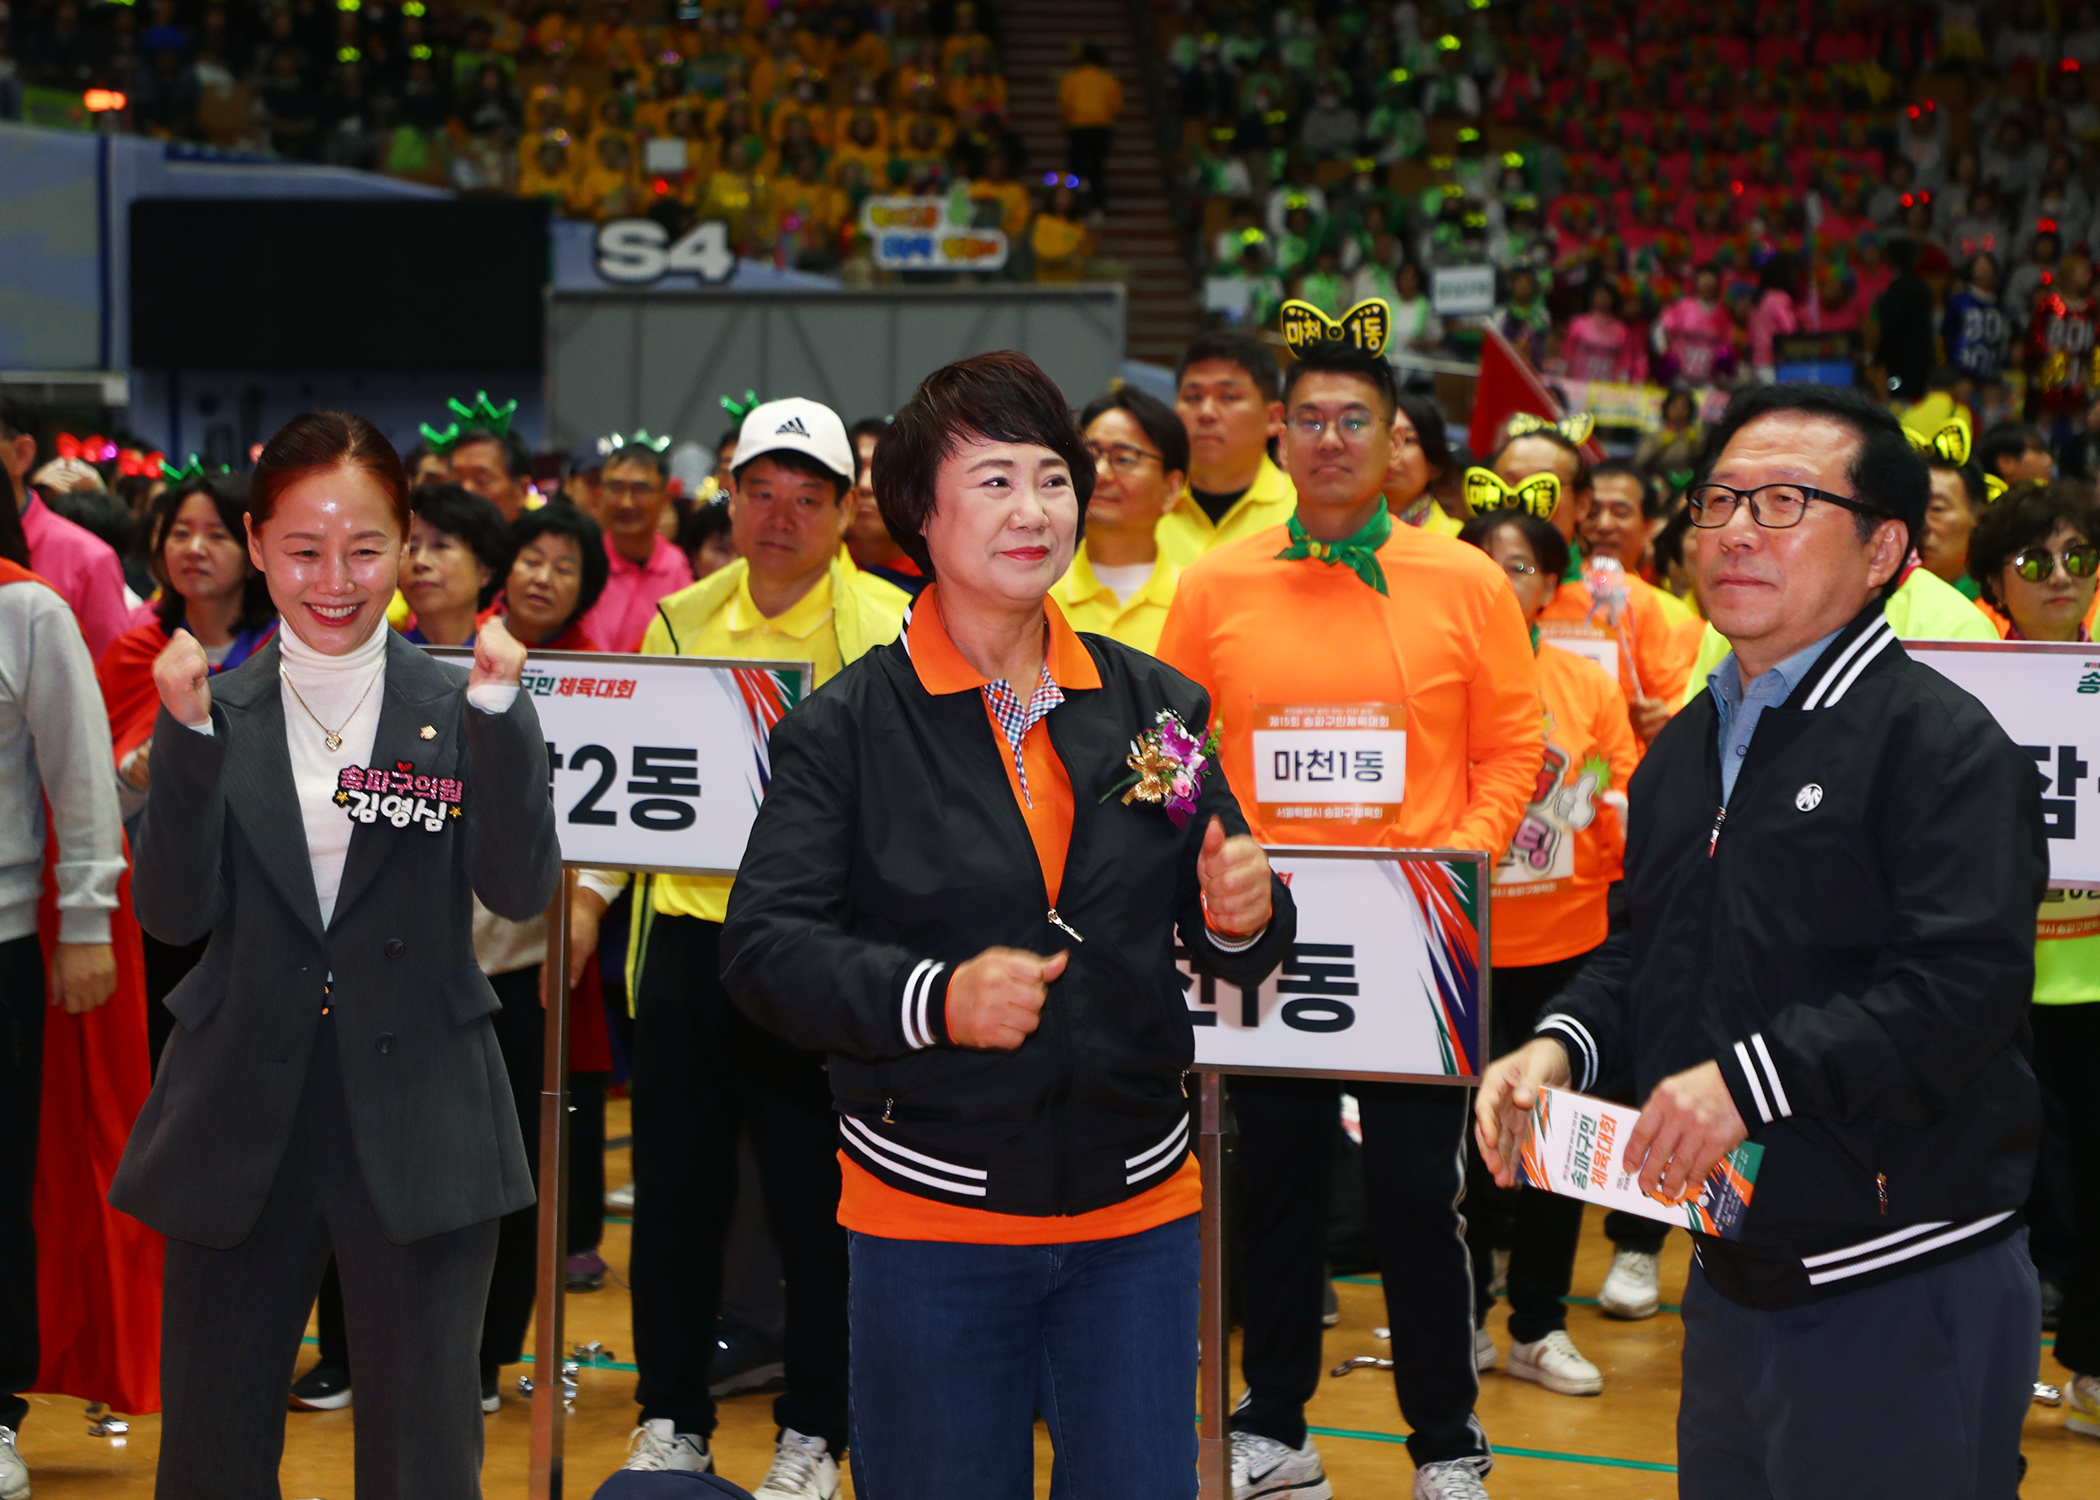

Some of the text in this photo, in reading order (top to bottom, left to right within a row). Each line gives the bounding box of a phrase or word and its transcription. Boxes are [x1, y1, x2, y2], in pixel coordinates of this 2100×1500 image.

[598, 217, 736, 282] S4
[556, 677, 637, 699] 체육대회
[340, 765, 464, 803] 송파구의원
[545, 741, 701, 832] 2동
[1274, 749, 1384, 783] 마천1동
[2018, 745, 2100, 840] 잠
[348, 788, 448, 832] 김영심
[1571, 1113, 1598, 1191] 송파구민
[1590, 1112, 1618, 1192] 체육대회
